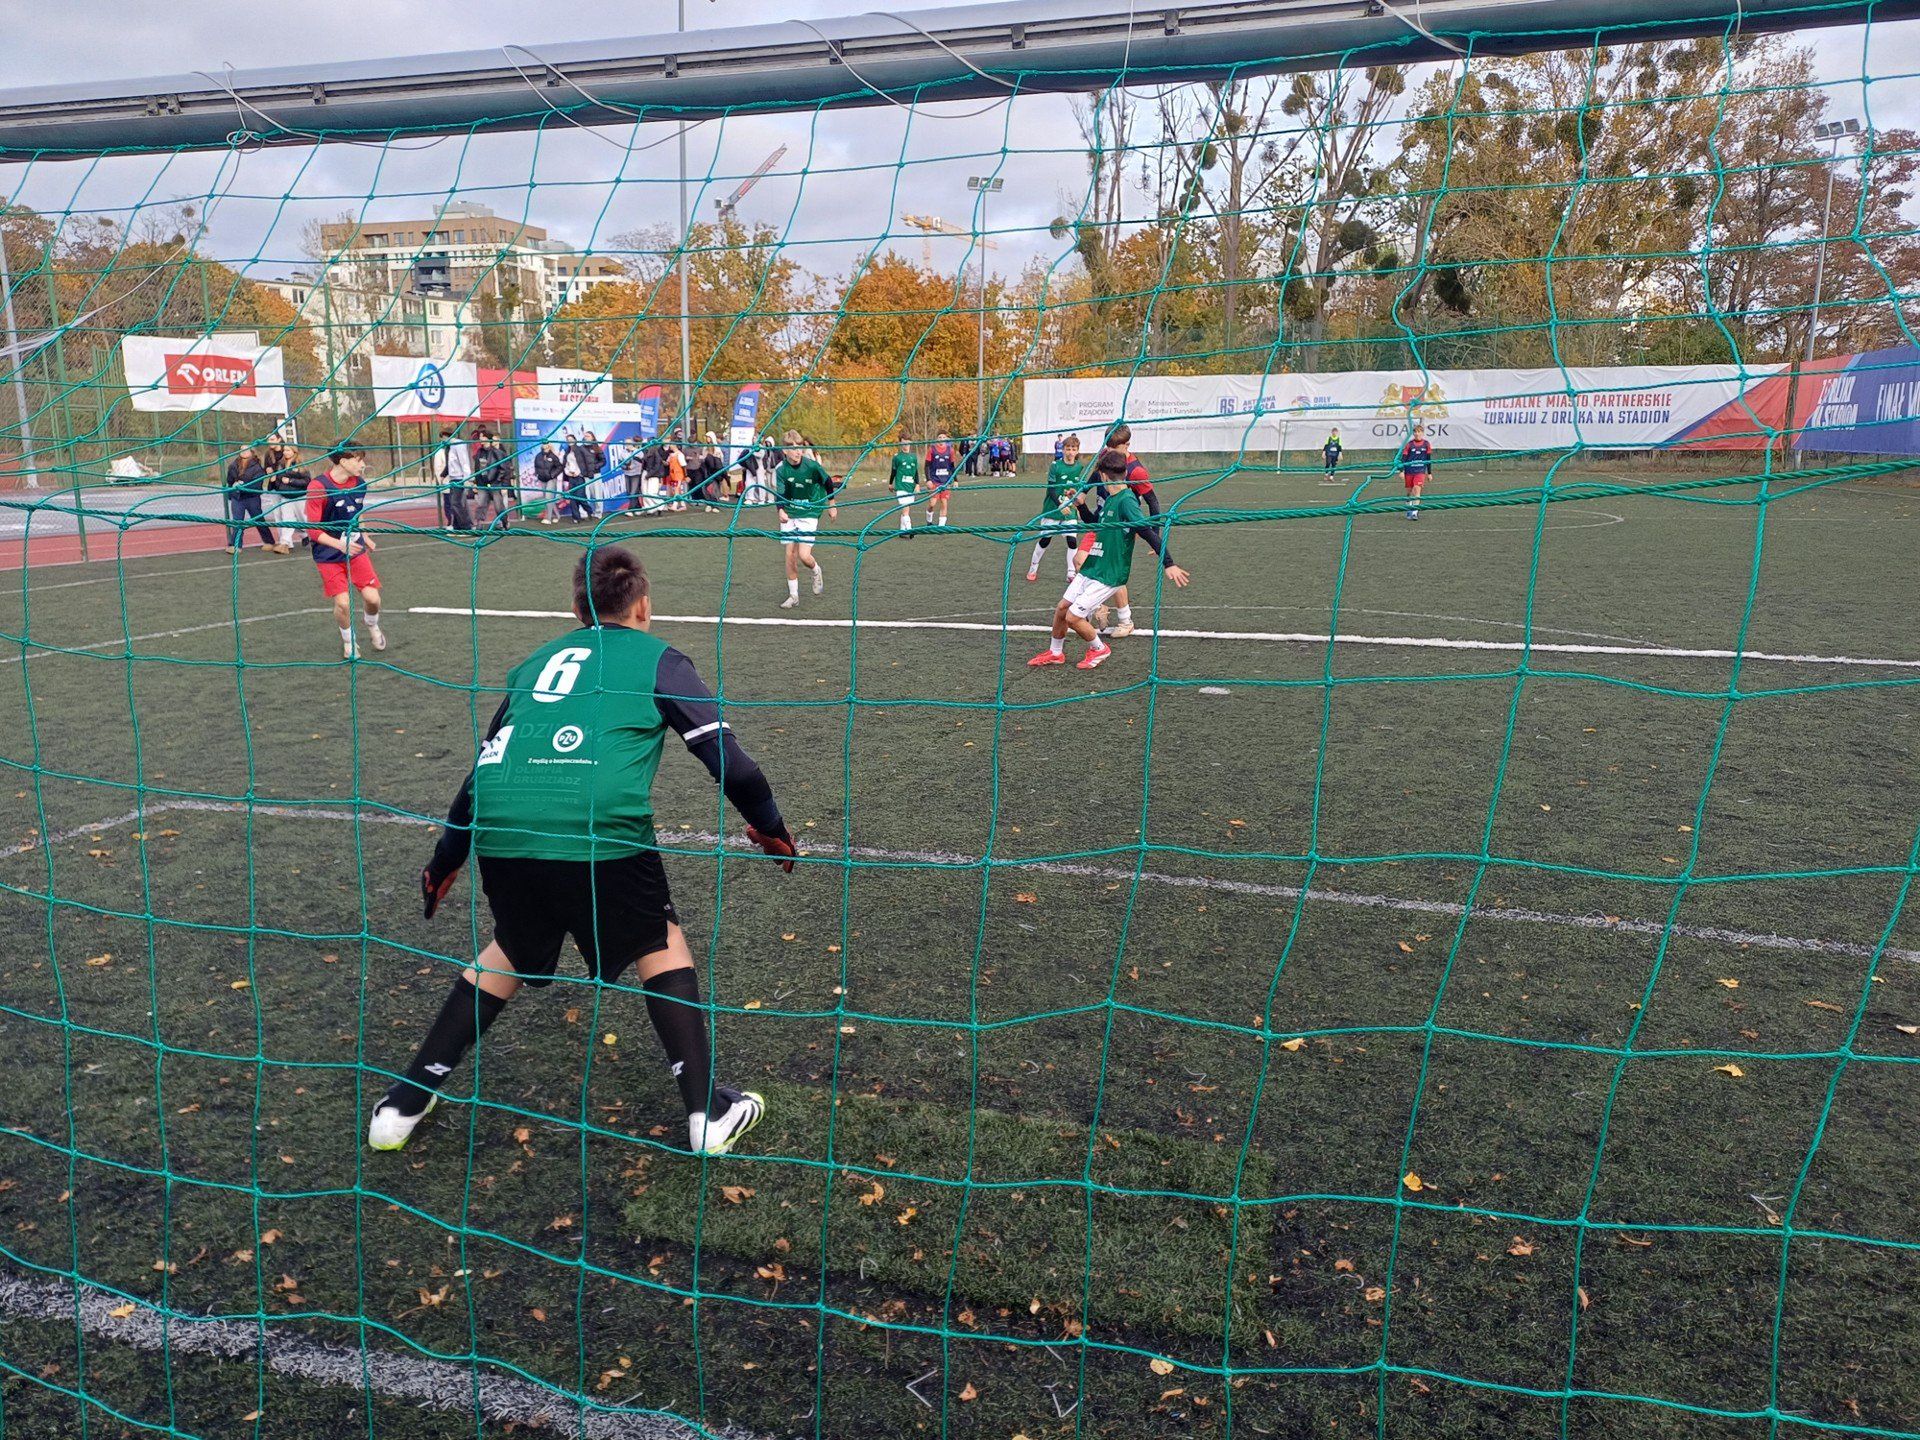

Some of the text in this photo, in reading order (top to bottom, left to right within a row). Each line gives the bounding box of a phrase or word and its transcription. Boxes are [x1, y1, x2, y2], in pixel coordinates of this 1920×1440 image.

[202, 367, 248, 385] ORLEN
[1079, 401, 1114, 409] PROGRAM
[1147, 400, 1190, 408] Ministerstwo
[1220, 398, 1235, 414] AS
[1242, 395, 1276, 407] AKTWNA
[1485, 393, 1672, 410] OFICJALNE MIASTO PARTNERSKIE
[1876, 382, 1905, 421] FINAŁ
[1079, 409, 1115, 417] RZĄDOWY
[1147, 408, 1168, 416] Sportu
[1484, 410, 1670, 424] TURNIEJU Z ORLKA NA STADION
[1372, 423, 1450, 437] GDASK
[532, 647, 592, 703] 6
[558, 732, 578, 745] PZU
[553, 757, 599, 766] bezpieczeństwe
